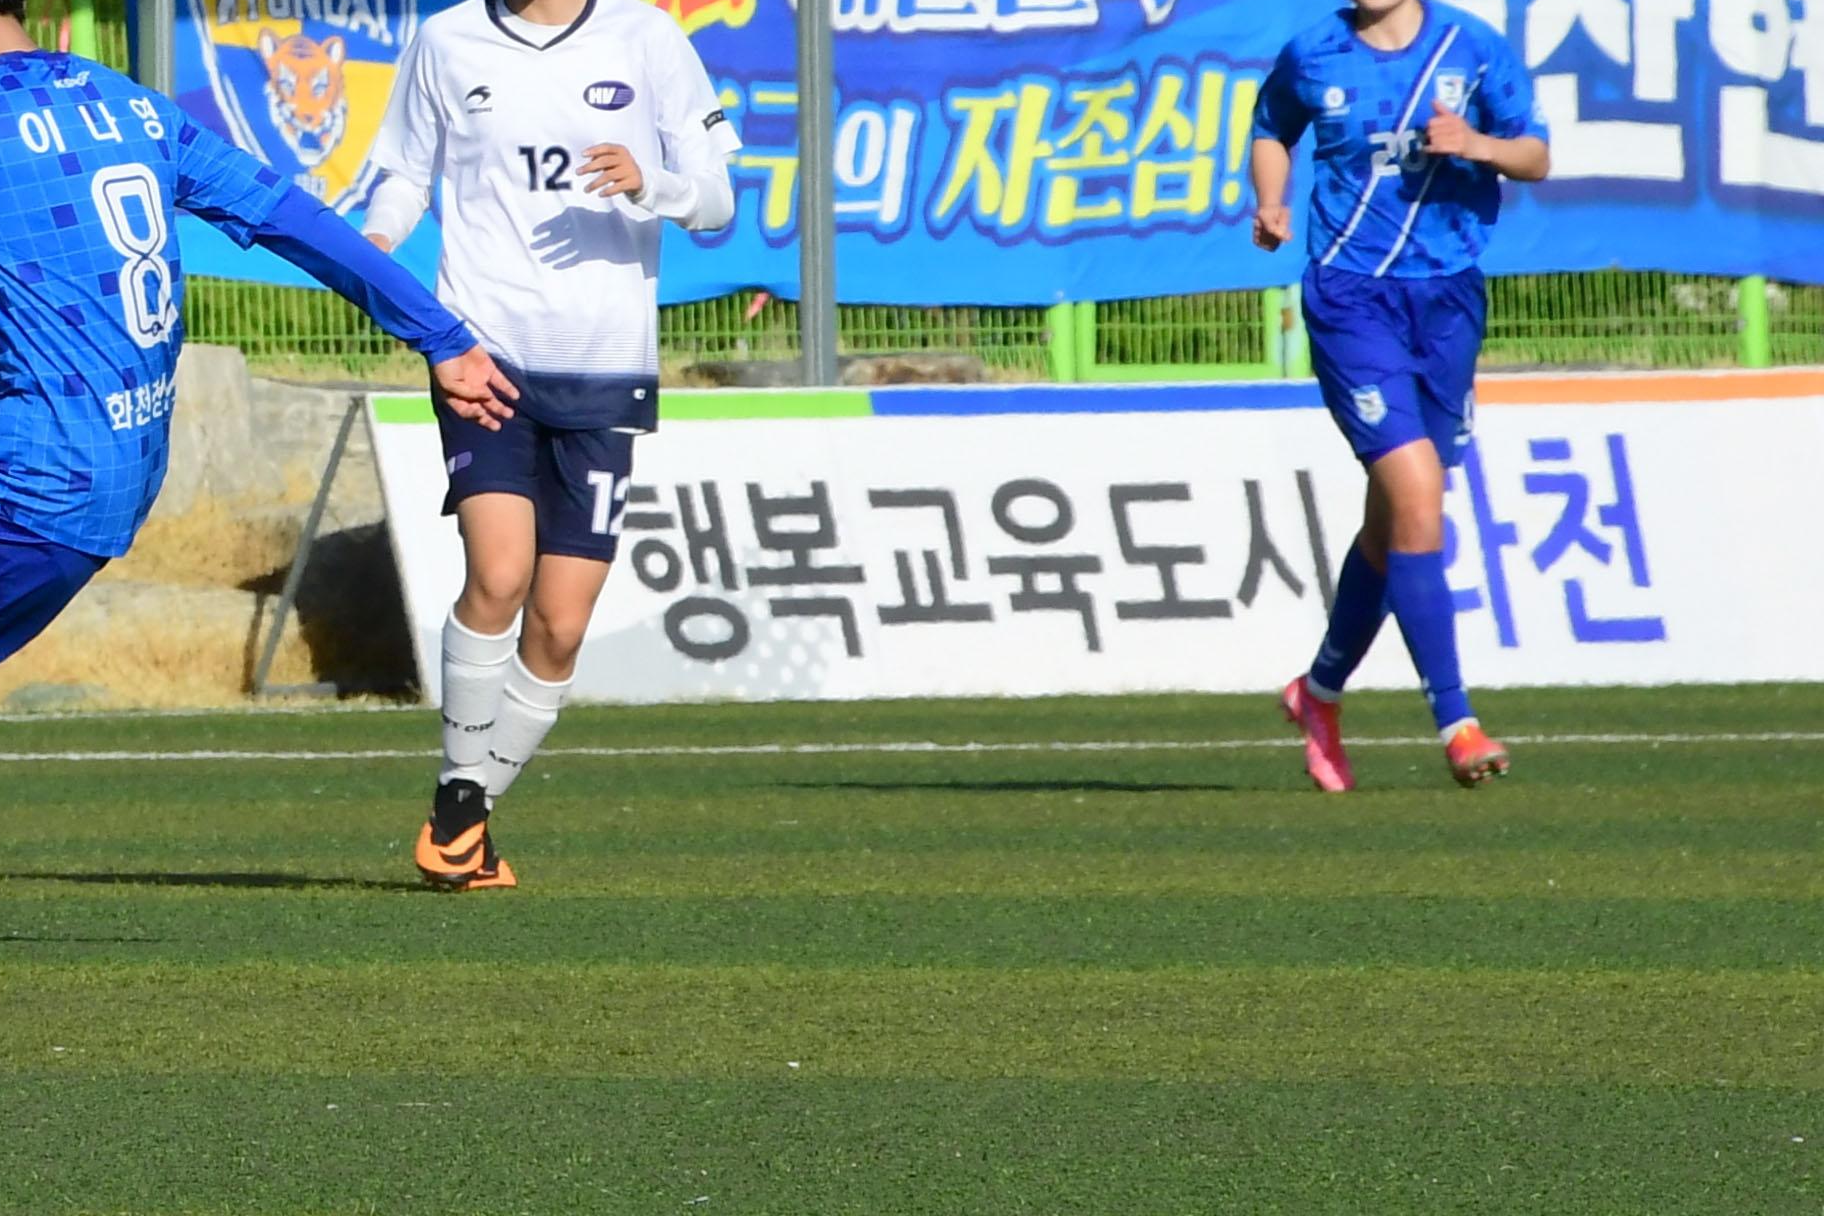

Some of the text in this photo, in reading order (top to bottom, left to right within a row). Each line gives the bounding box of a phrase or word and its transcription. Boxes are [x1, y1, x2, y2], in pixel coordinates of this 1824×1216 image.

[517, 145, 573, 192] 12
[934, 71, 1257, 227] 자존심!
[90, 162, 179, 349] 8
[622, 469, 1336, 664] 행복교육도시
